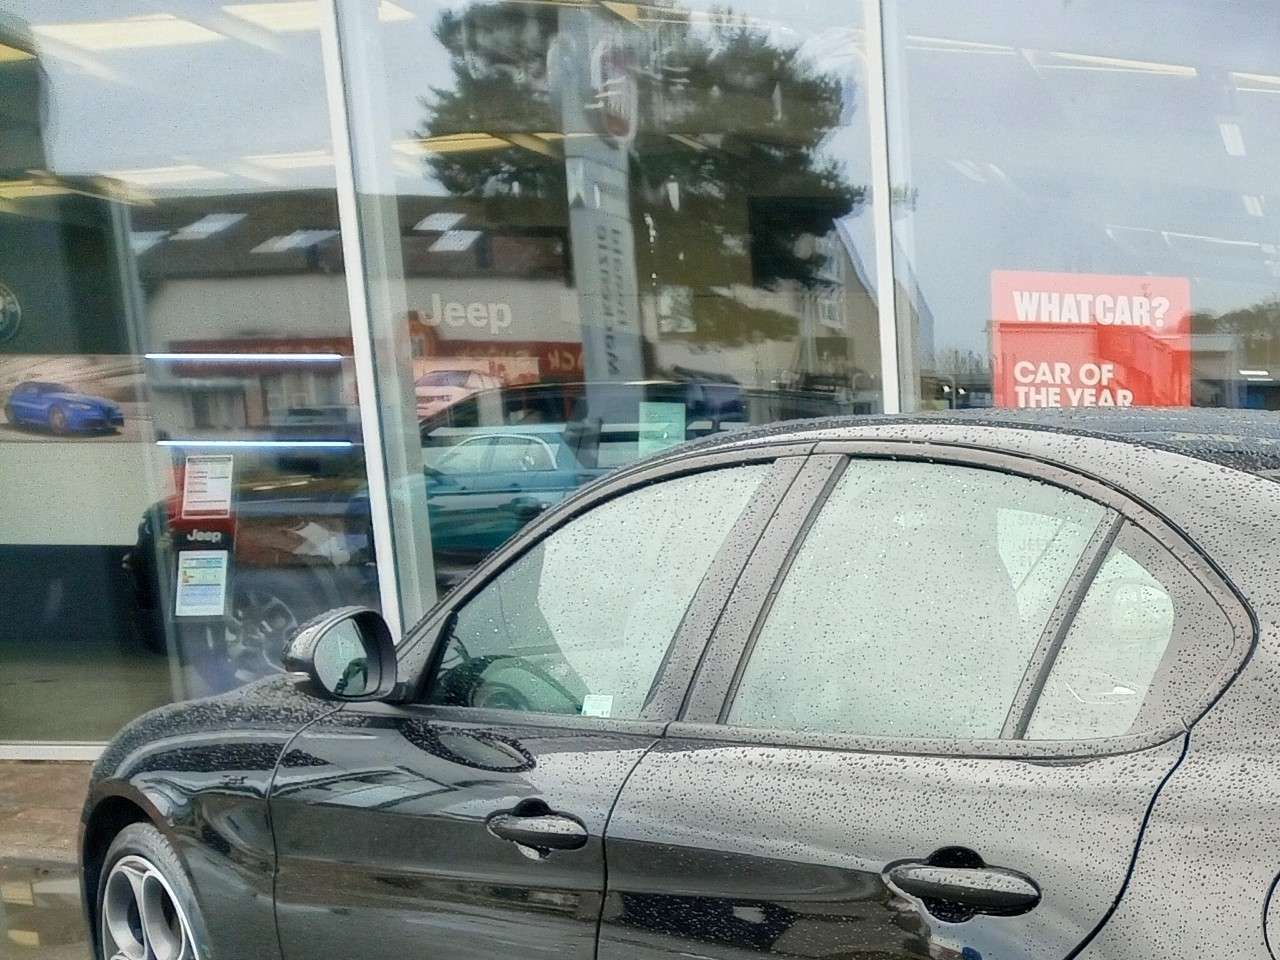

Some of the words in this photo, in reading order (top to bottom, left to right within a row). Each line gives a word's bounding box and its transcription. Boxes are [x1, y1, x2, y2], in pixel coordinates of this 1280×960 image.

[417, 293, 513, 335] Jeep
[1014, 361, 1071, 385] CAR
[1079, 363, 1114, 385] OF
[1015, 386, 1060, 408] THE
[1066, 388, 1133, 408] YEAR
[187, 529, 222, 544] Jeep
